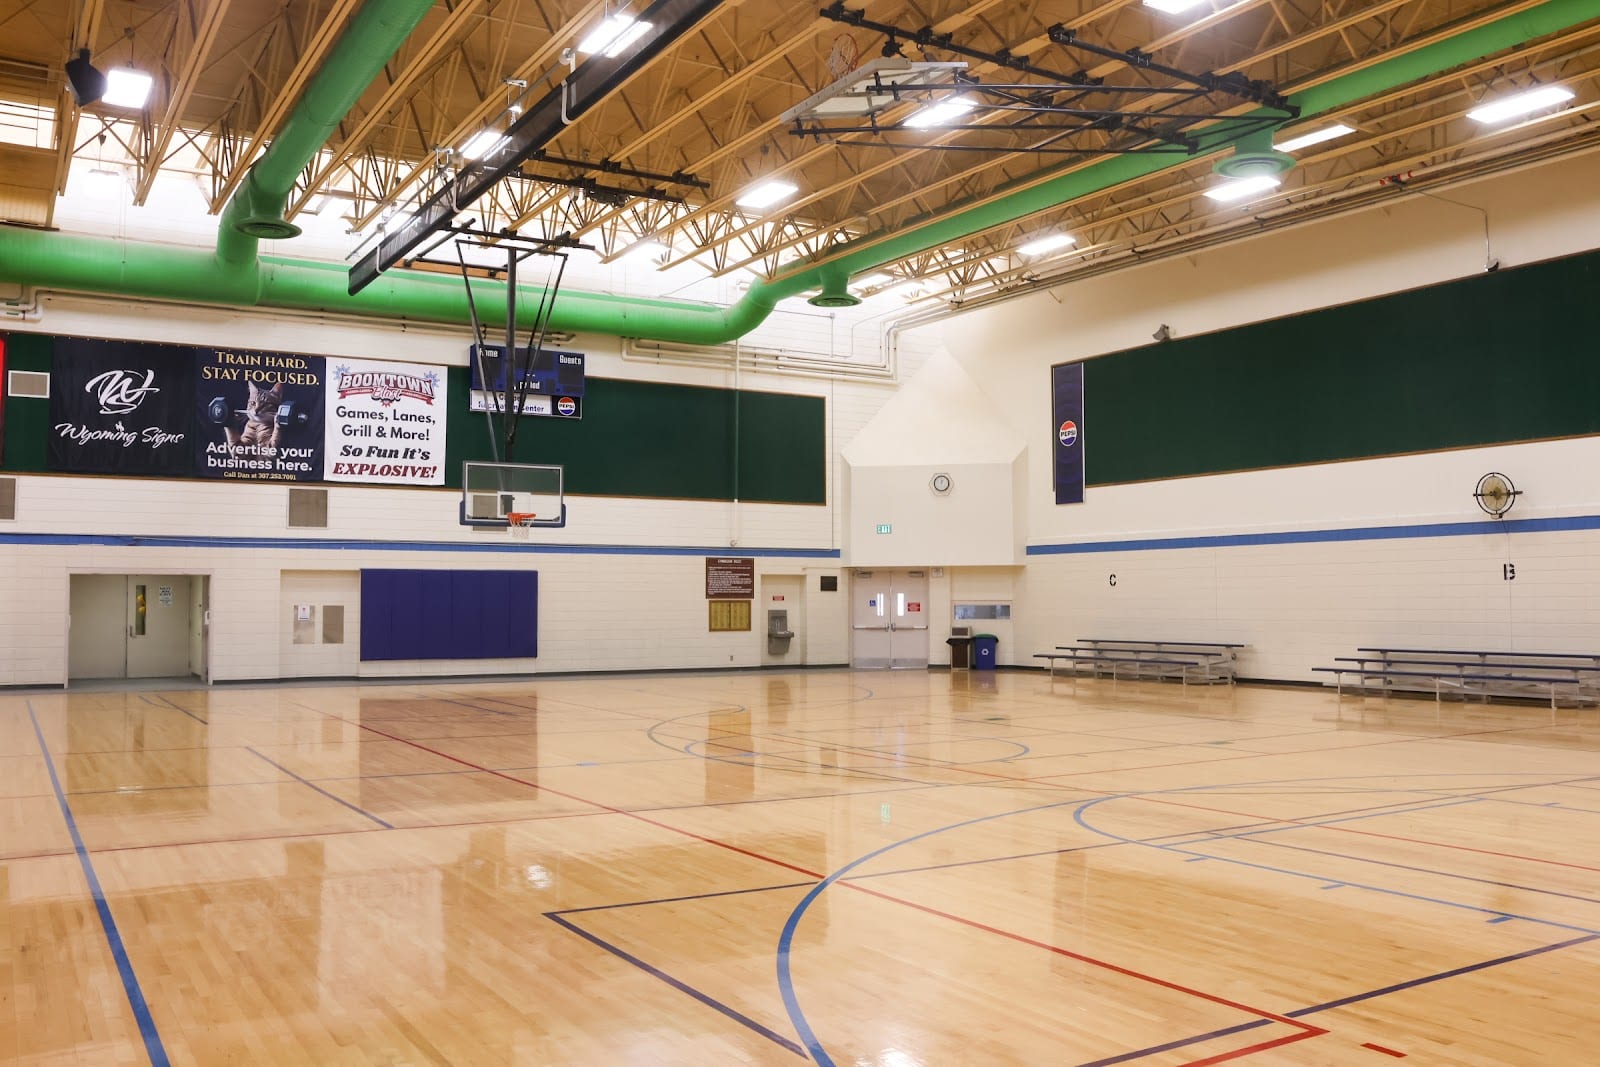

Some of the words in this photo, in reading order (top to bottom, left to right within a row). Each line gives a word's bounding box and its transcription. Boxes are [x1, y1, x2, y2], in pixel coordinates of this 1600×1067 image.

[215, 351, 262, 366] TRAIN
[265, 356, 308, 370] HARD.
[202, 366, 239, 380] STAY
[244, 369, 319, 386] FOCUSED.
[340, 373, 433, 396] BOOMTOWN
[336, 406, 389, 422] Games,
[393, 409, 436, 426] Lanes,
[54, 423, 138, 448] Wyoming
[141, 426, 184, 449] Signs
[342, 424, 372, 438] Grill
[376, 426, 387, 438] &
[390, 427, 430, 441] More!
[206, 442, 278, 456] Advertise
[280, 447, 314, 460] your
[340, 445, 363, 457] So
[365, 446, 399, 459] Fun
[402, 447, 431, 461] It's
[207, 455, 273, 470] business
[276, 458, 313, 471] here.
[332, 463, 437, 479] EXPLOSIVE!
[1503, 563, 1516, 580] B
[1109, 574, 1117, 587] C
